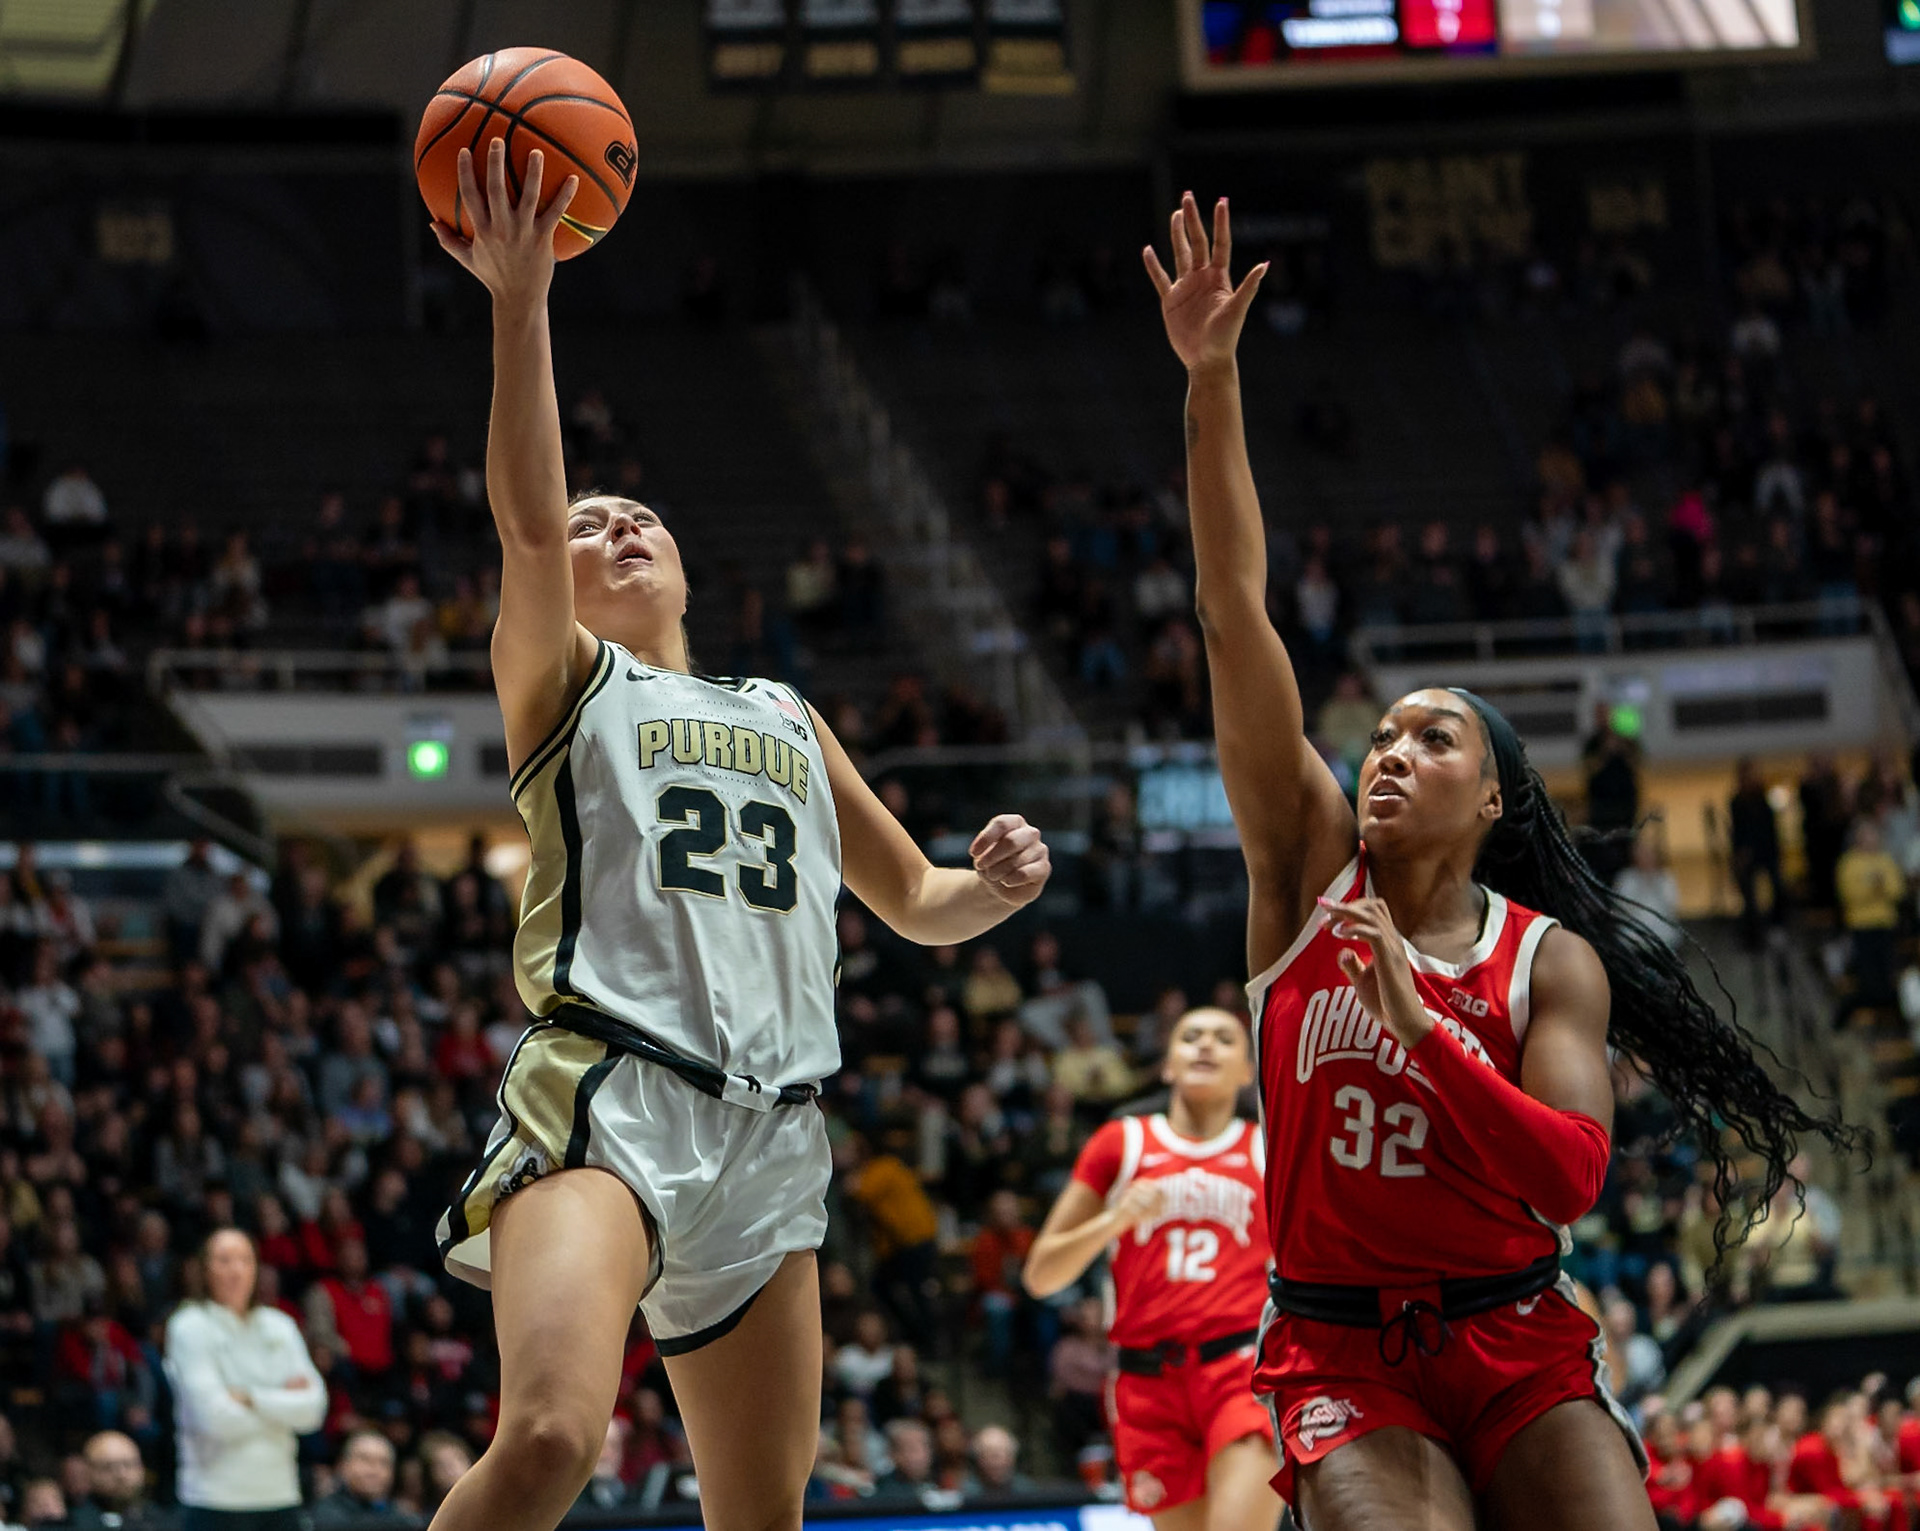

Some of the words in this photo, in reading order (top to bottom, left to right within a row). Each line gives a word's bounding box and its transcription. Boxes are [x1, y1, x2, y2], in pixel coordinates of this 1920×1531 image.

[637, 718, 809, 806] PURDUE
[655, 784, 799, 915] 23
[1329, 1084, 1430, 1178] 32
[1166, 1228, 1219, 1283] 12
